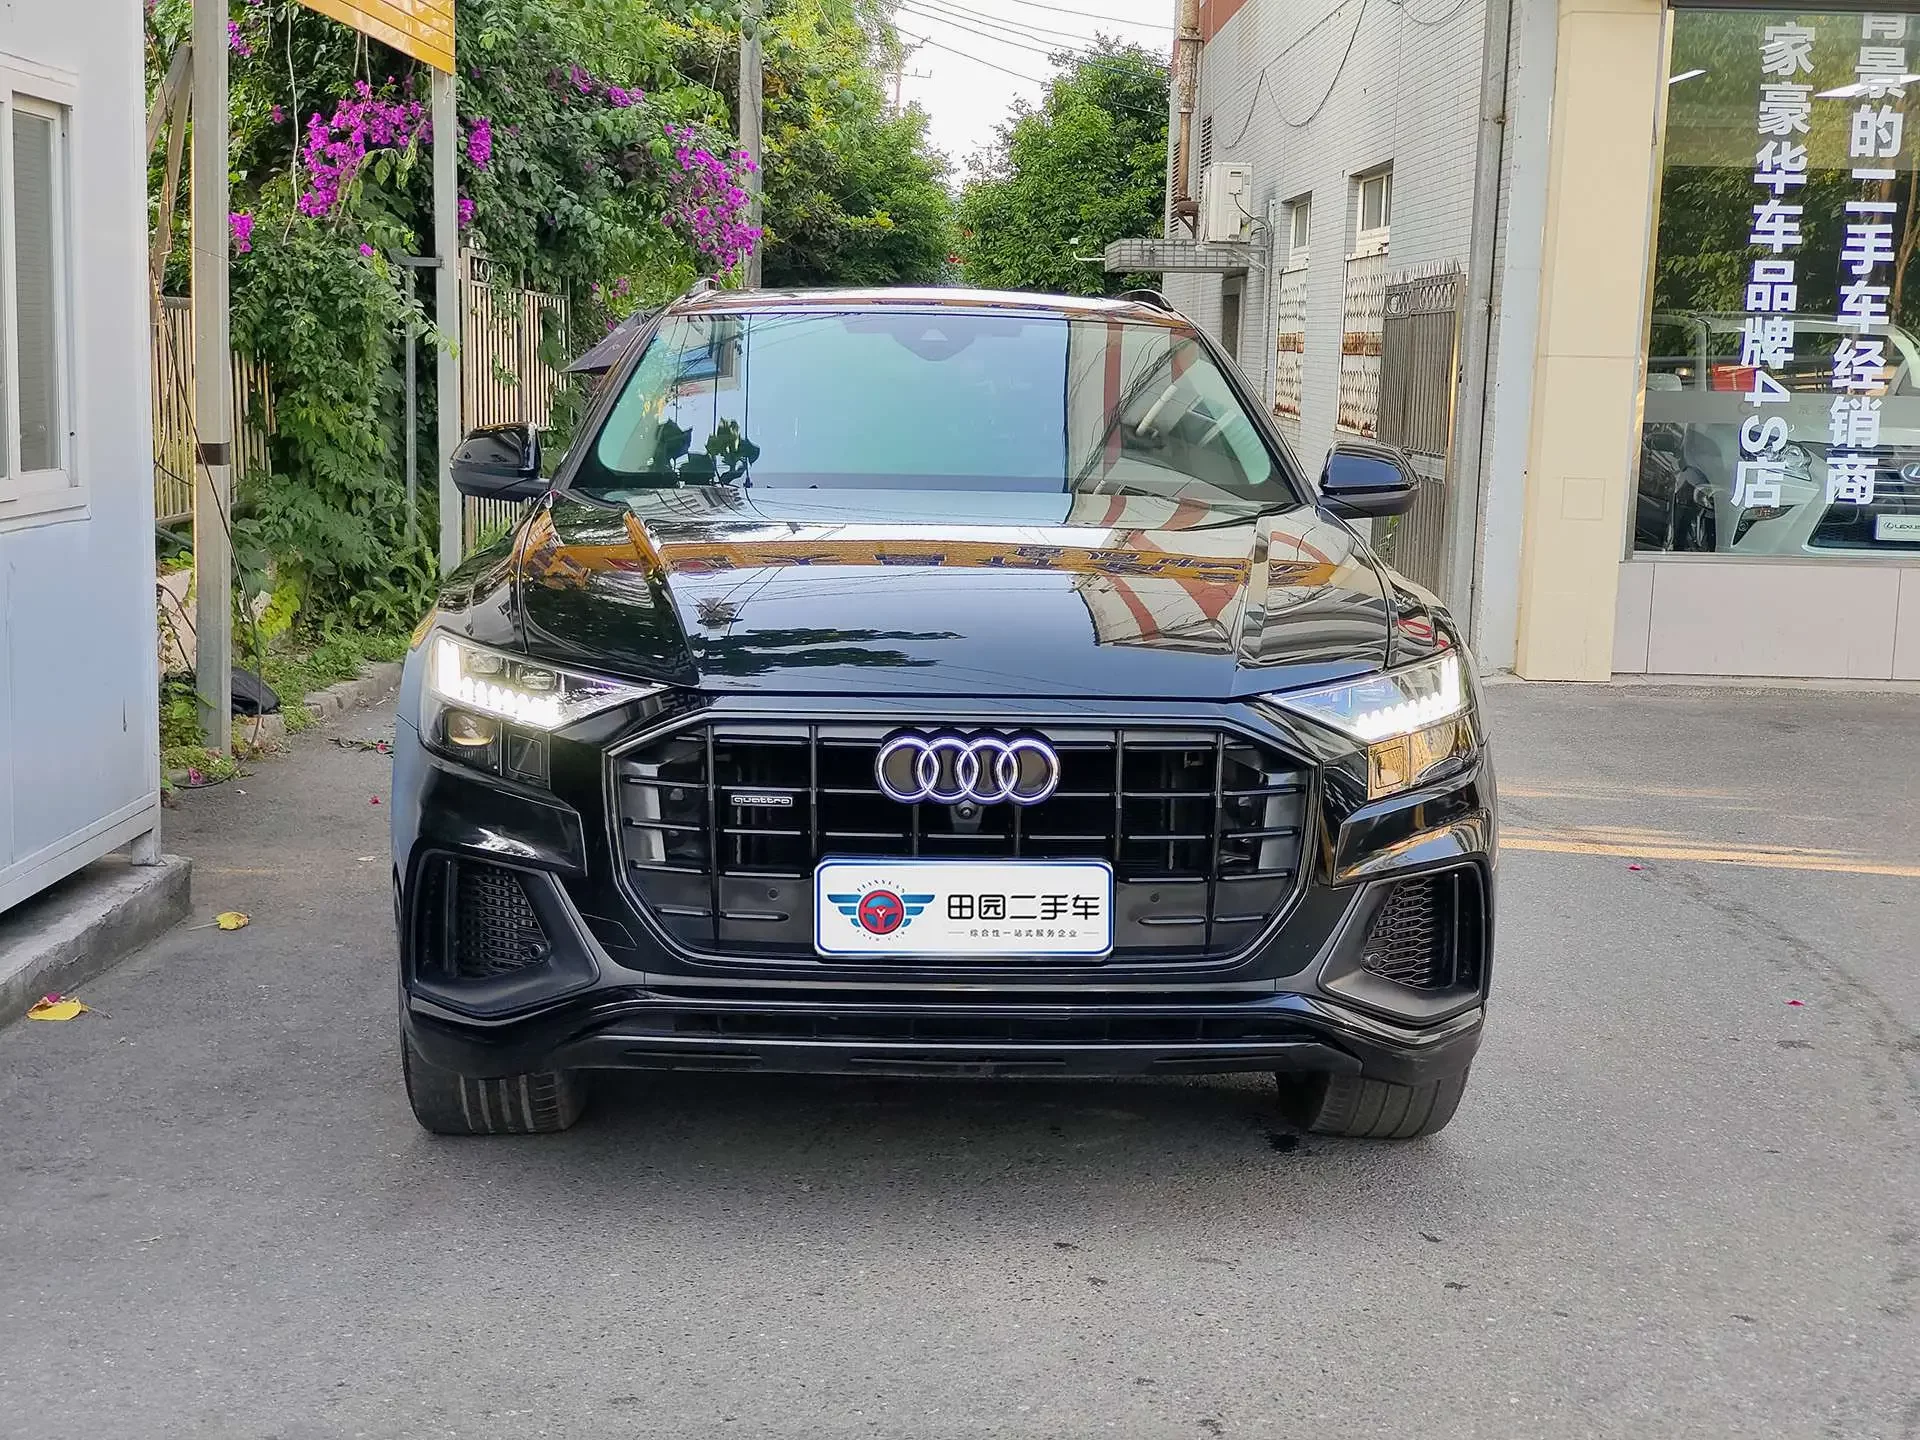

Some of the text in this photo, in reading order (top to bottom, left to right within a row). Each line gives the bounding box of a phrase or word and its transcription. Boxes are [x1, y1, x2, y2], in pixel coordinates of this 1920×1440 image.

[1731, 22, 1815, 508] 家豪华车品牌4S店
[733, 796, 790, 805] quattro
[947, 893, 1100, 920] 田园二手车
[969, 928, 1078, 938] 综合性一站式服务企业
